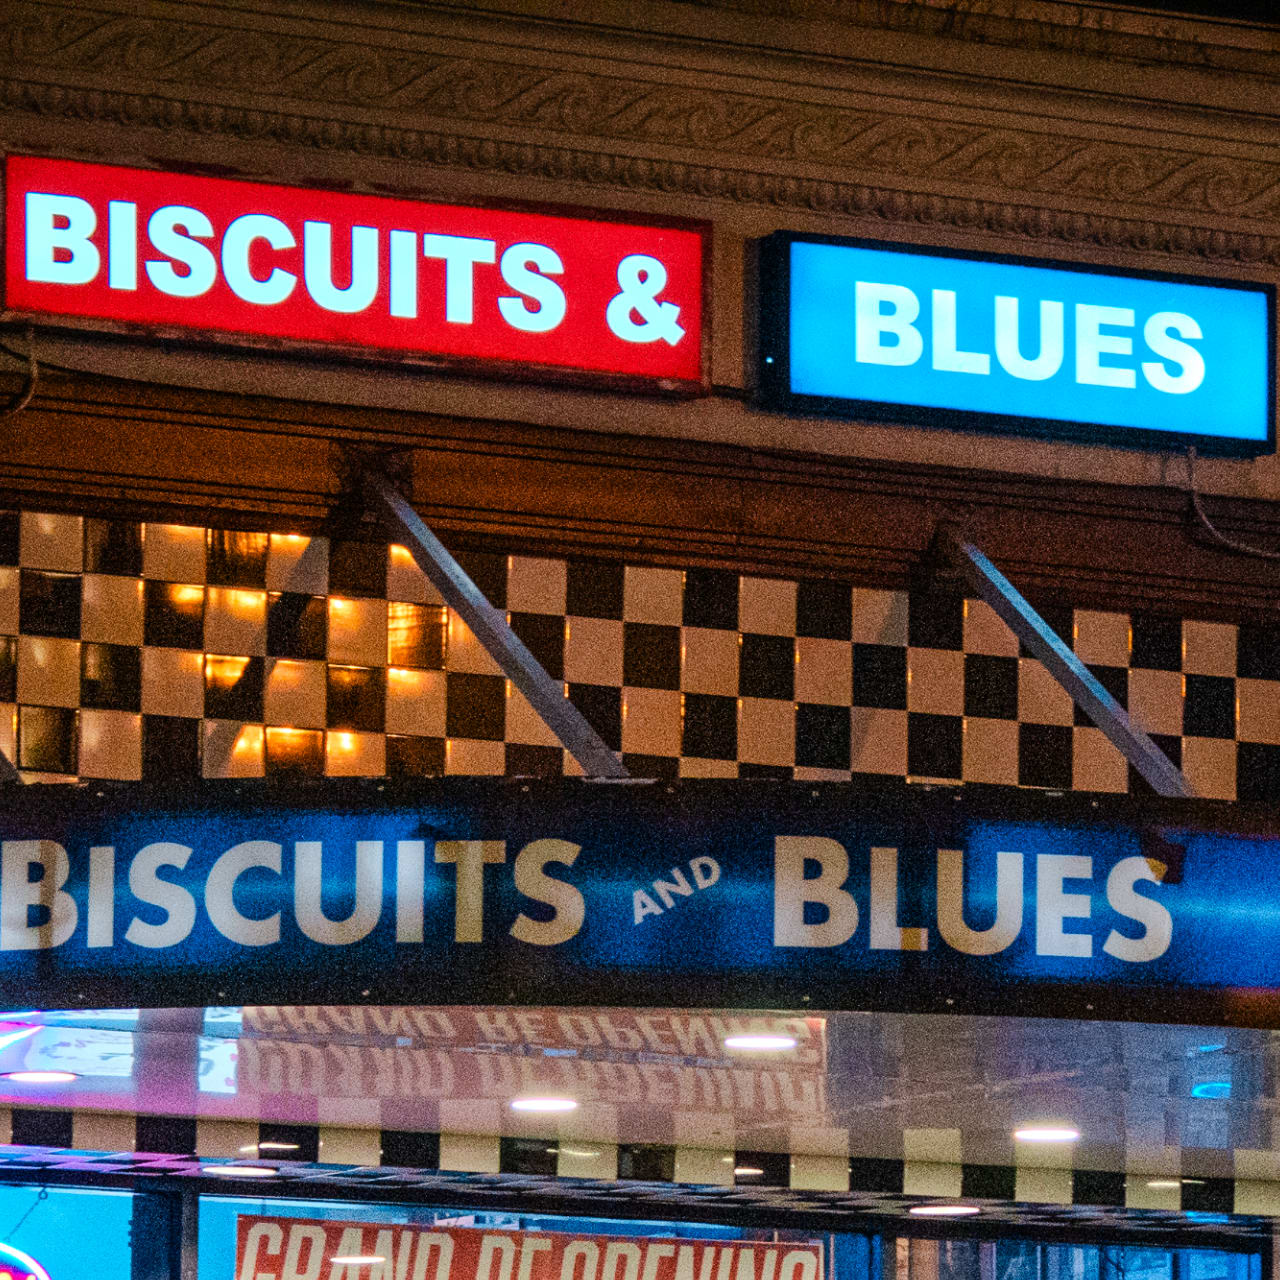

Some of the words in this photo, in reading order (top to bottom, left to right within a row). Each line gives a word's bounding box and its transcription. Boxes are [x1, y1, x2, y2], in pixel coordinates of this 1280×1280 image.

[24, 191, 568, 334] BISCUITS
[606, 254, 687, 345] &
[853, 281, 1205, 393] BLUES
[0, 838, 586, 951] BISCUITS
[631, 855, 721, 925] AND
[773, 835, 1174, 963] BLUES
